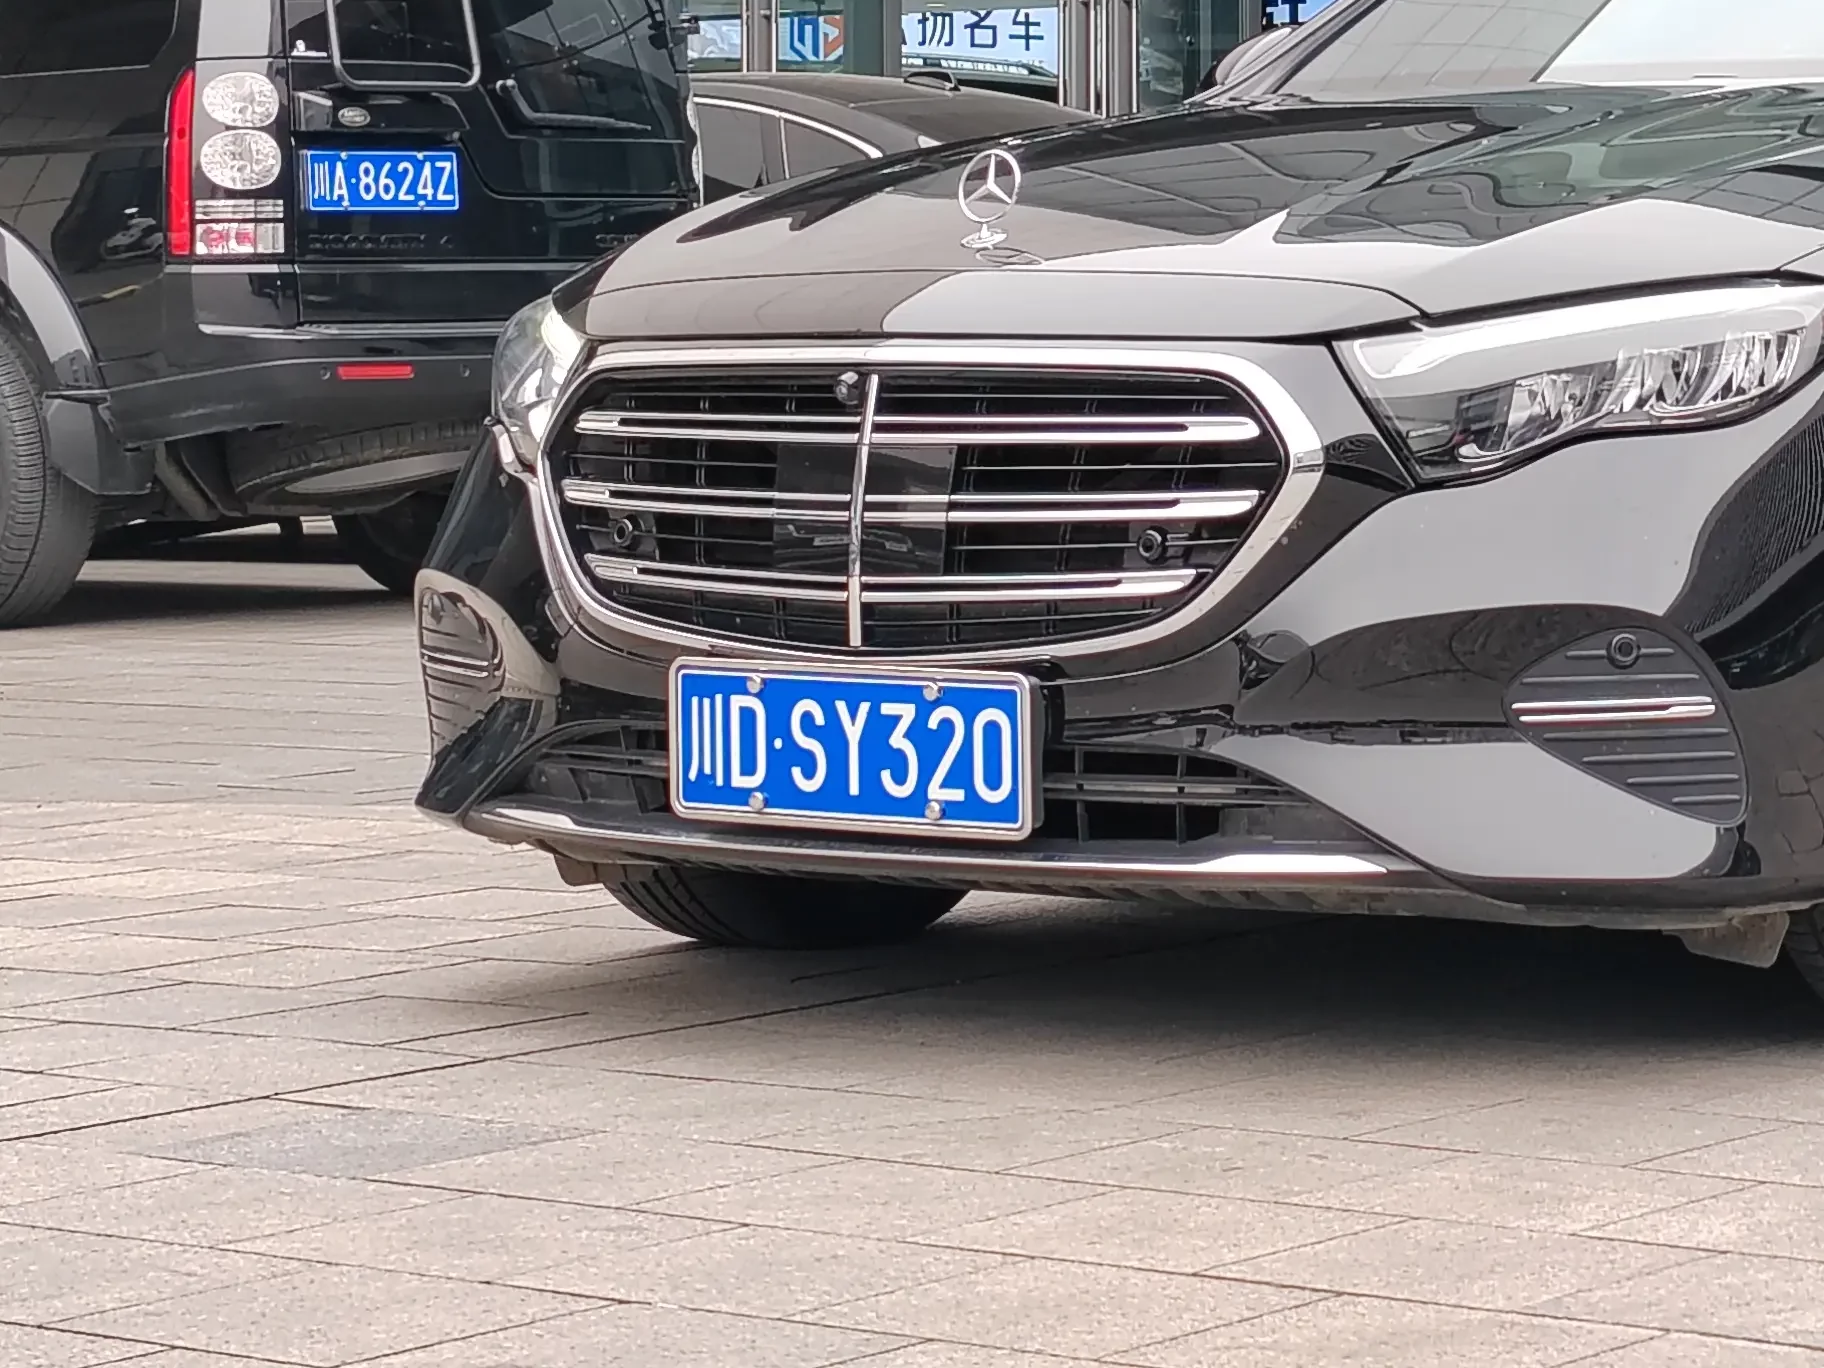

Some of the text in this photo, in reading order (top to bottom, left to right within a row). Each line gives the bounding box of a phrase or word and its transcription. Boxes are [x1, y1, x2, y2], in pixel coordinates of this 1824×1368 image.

[902, 8, 1044, 51] 扬名车
[314, 160, 455, 202] 川A·8624Z
[687, 693, 1013, 804] 川D·SY320
